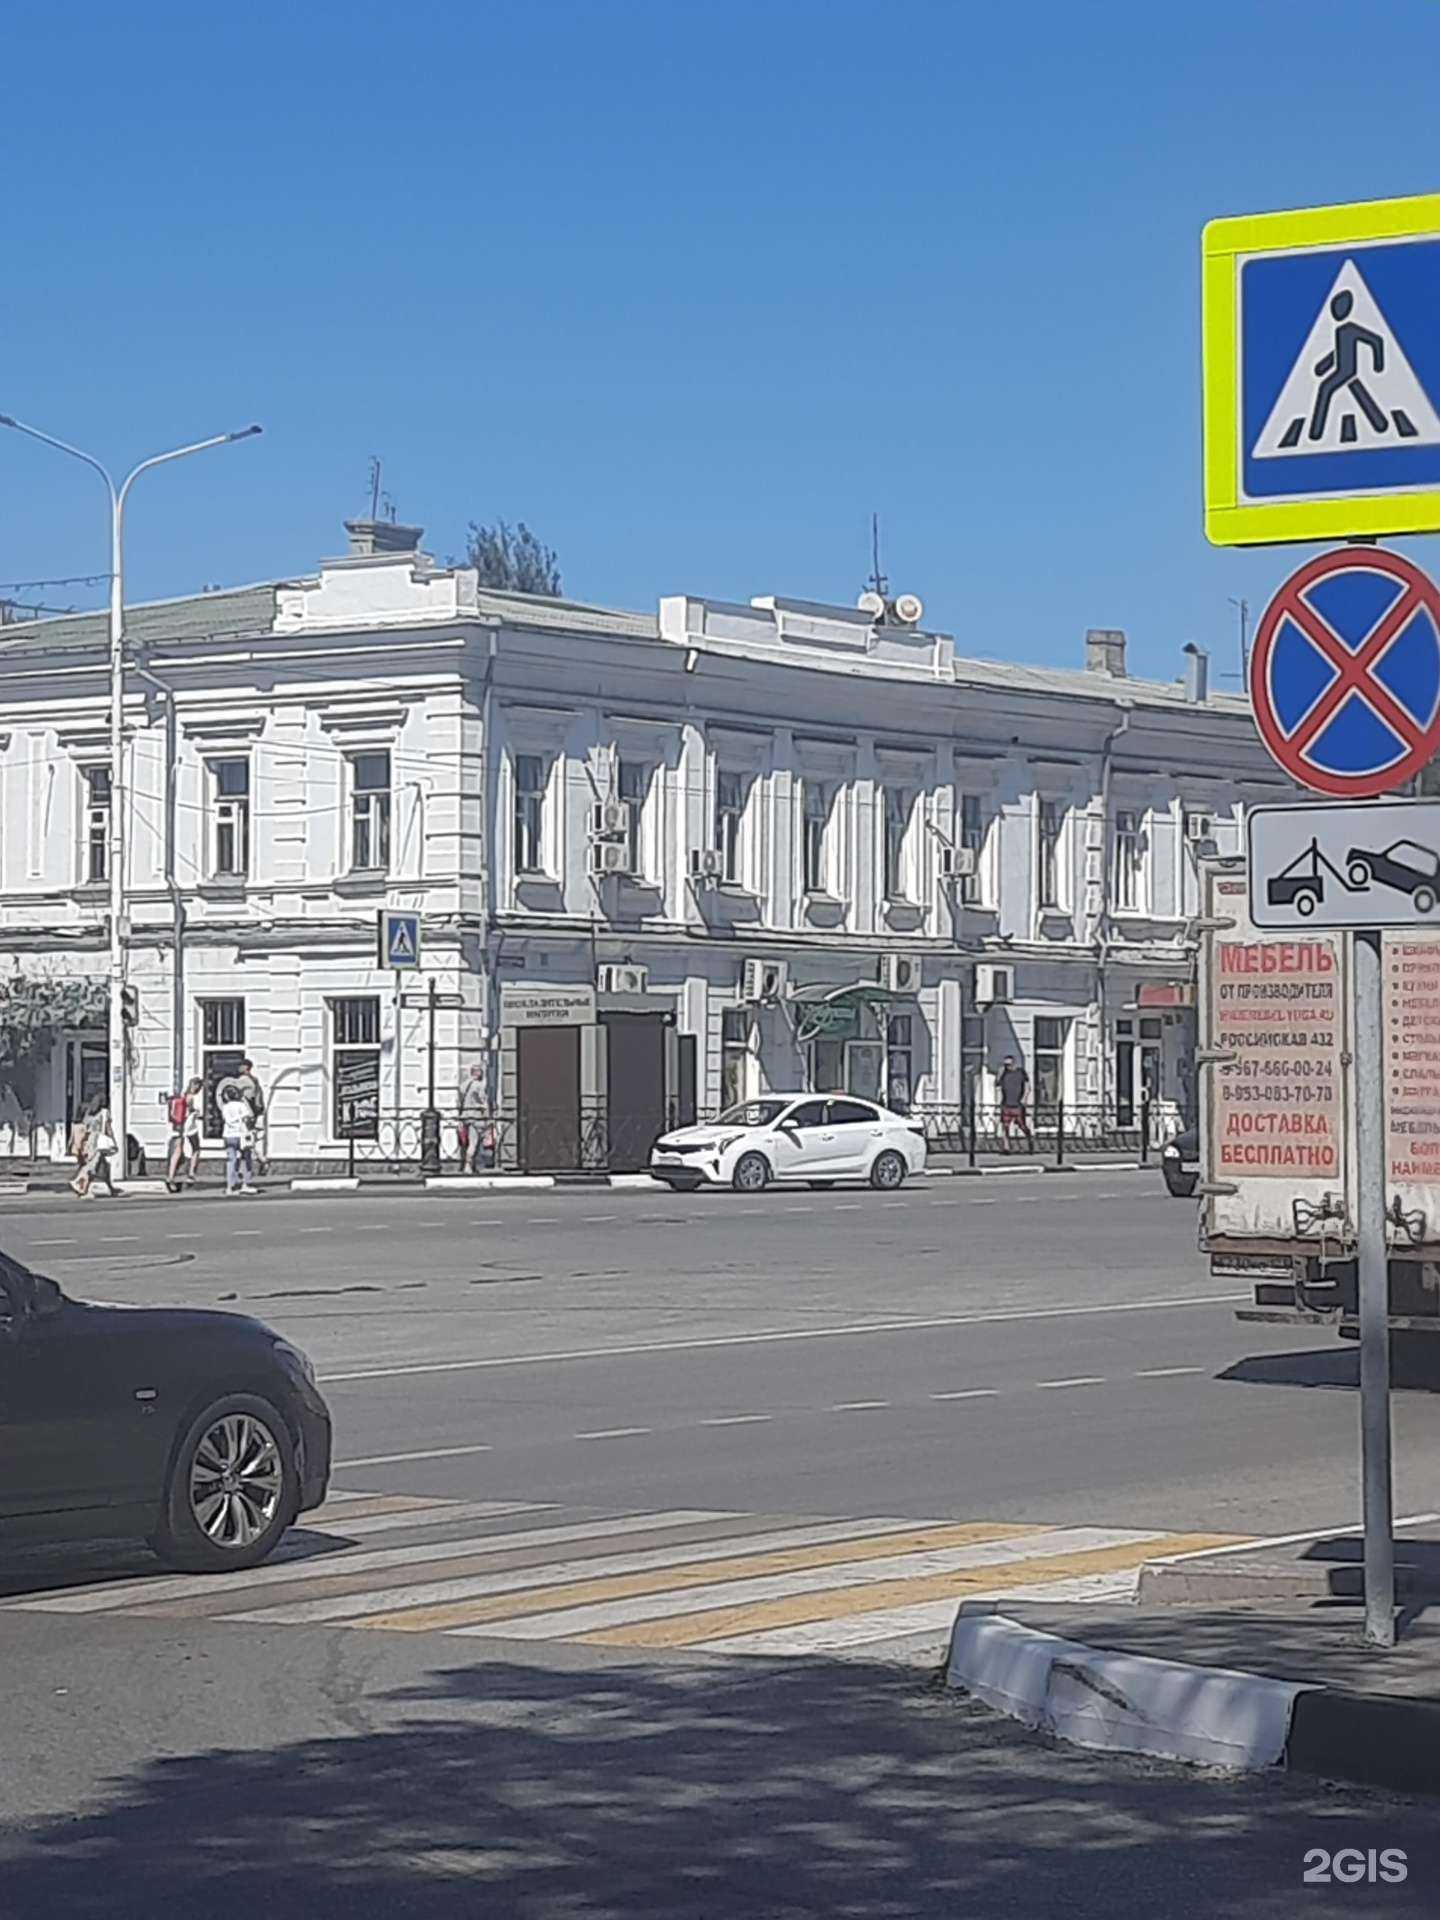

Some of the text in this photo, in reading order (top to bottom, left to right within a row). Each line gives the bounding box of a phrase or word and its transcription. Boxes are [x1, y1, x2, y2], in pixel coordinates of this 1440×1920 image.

[1220, 943, 1333, 973] МЕБЕЛЬ
[1220, 983, 1333, 1001] ОТ ПРОИЗВОДИТЕЛЯ
[1226, 1112, 1329, 1137] ДОСТАВКА
[1221, 1143, 1334, 1166] БЕСПЛАТНО
